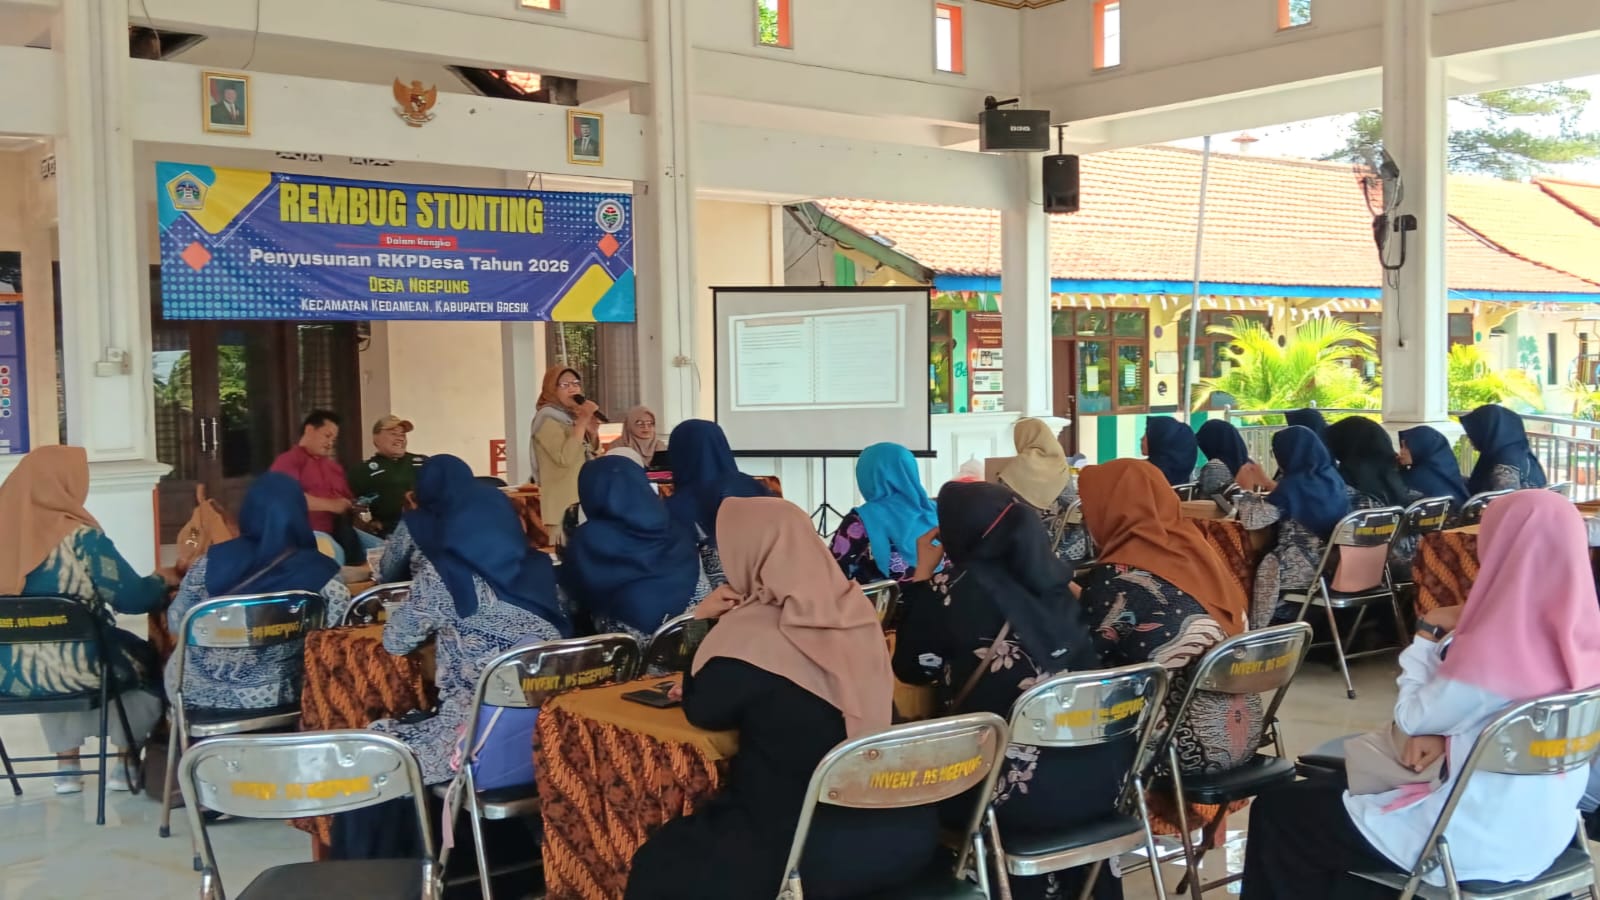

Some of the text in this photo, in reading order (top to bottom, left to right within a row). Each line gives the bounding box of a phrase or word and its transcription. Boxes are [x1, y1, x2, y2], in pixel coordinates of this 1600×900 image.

[279, 182, 544, 234] REMBUG STUNTING
[249, 248, 569, 272] Penyusunan RKPDesa Tahun 2026
[368, 276, 470, 294] DESA NGEPUNG
[301, 298, 368, 311] KECAMATAN
[435, 300, 494, 313] KABUPATEN
[497, 301, 529, 313] GRESIK
[870, 769, 920, 788] INVENT.
